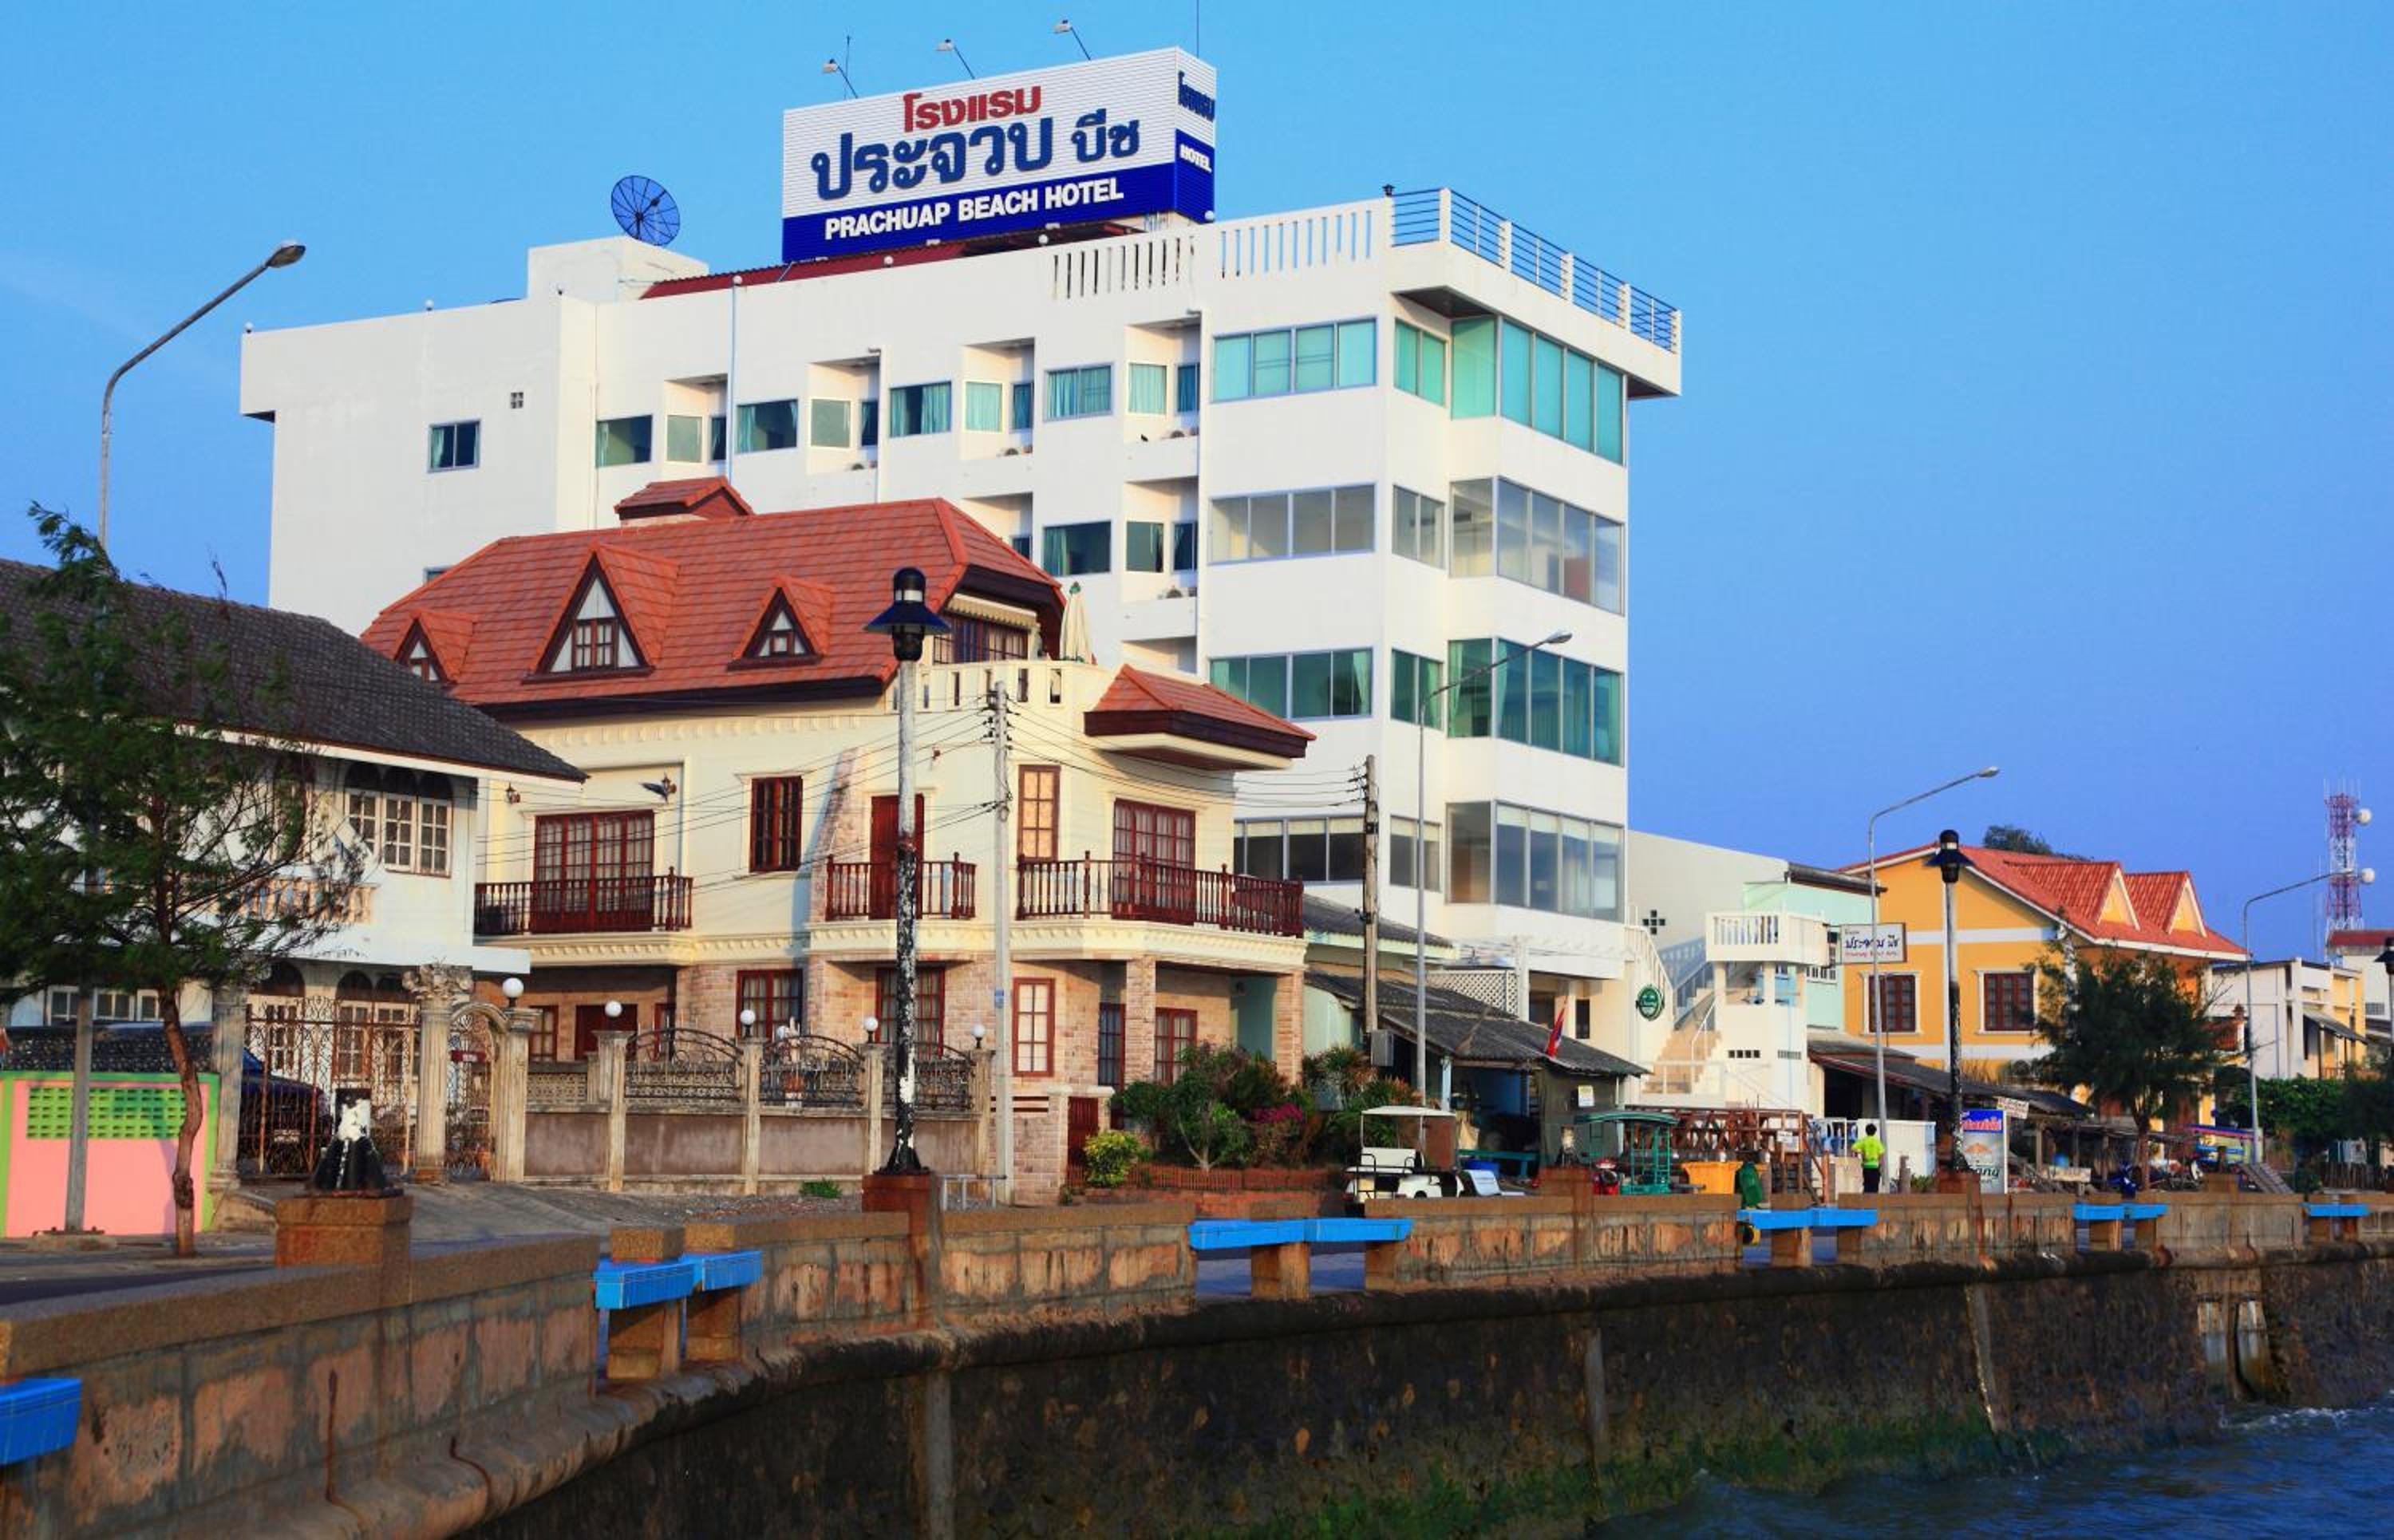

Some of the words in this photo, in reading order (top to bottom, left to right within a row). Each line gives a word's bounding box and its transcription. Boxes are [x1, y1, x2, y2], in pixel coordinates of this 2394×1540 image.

[903, 85, 1041, 133] โรงแรม
[811, 116, 1053, 200] ประจวบ
[1179, 144, 1211, 172] HOTEL
[824, 201, 951, 240] PRACHUAP
[958, 188, 1039, 223] BEACH
[1044, 176, 1124, 211] HOTEL
